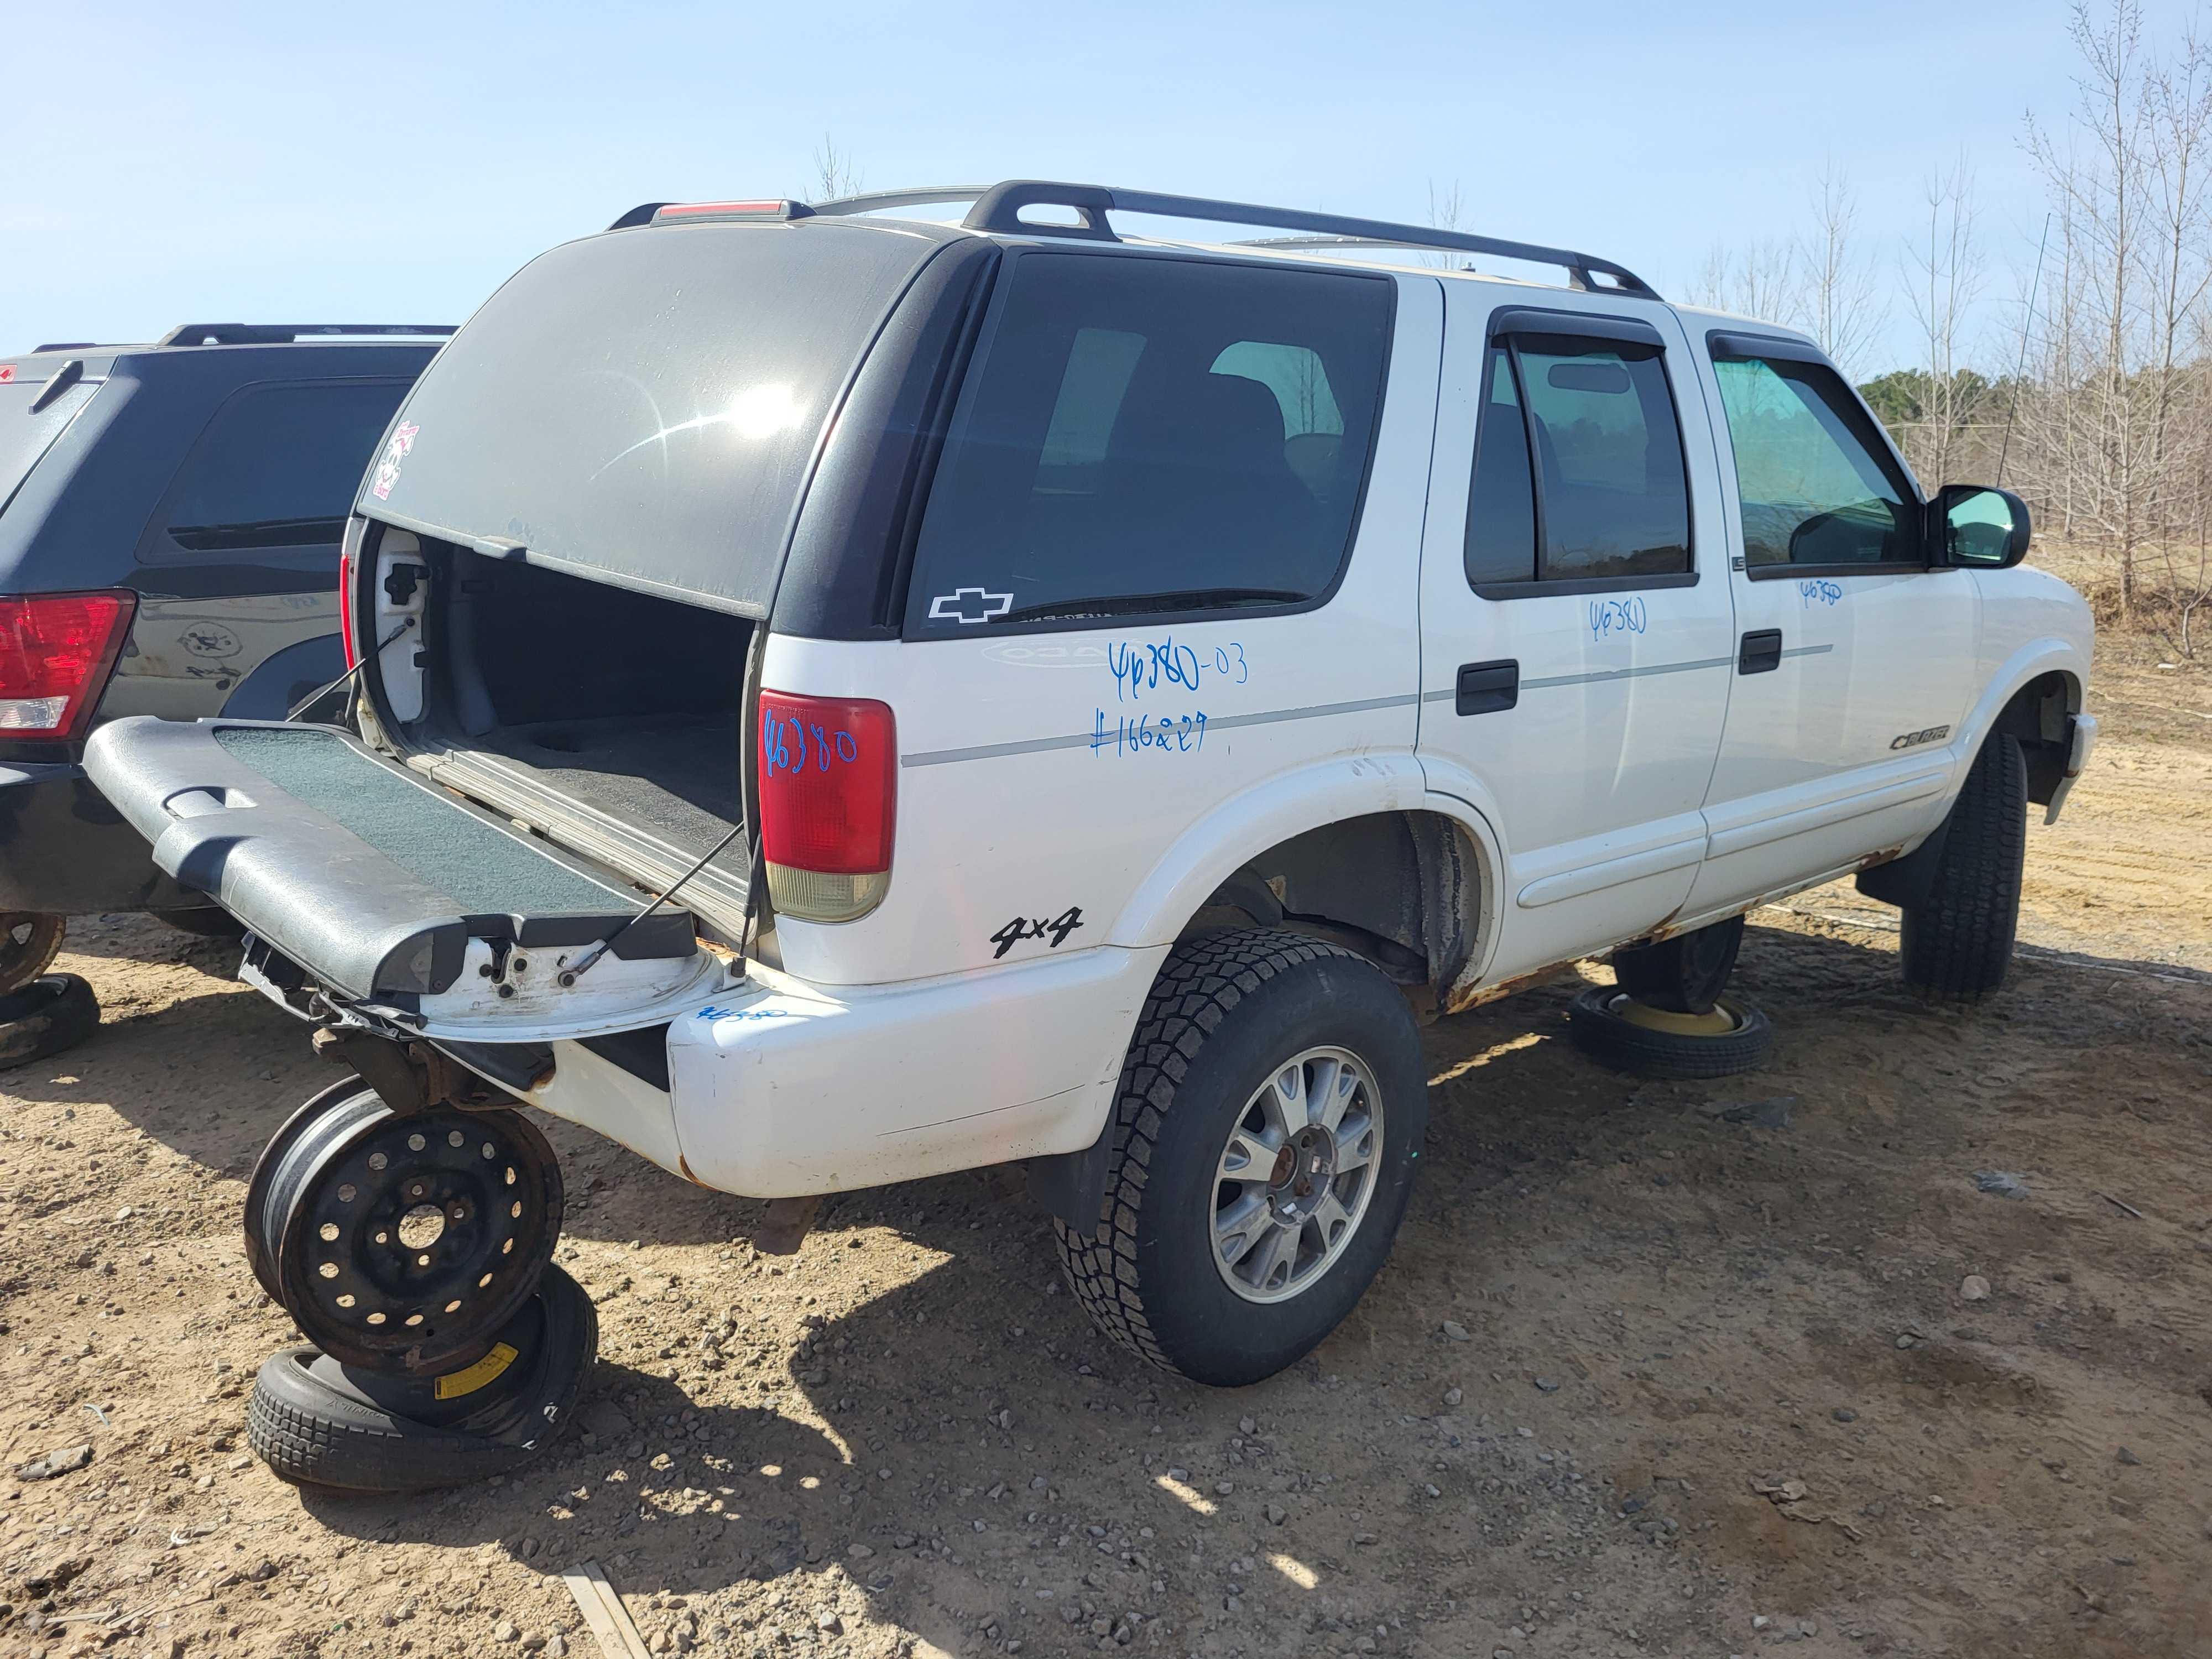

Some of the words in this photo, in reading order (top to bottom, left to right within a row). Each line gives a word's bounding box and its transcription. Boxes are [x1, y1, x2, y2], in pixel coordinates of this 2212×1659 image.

[1589, 597, 1646, 642] 46380
[1801, 581, 1842, 609] 46380
[1108, 635, 1248, 703] 46380-03
[764, 709, 857, 778] 46380
